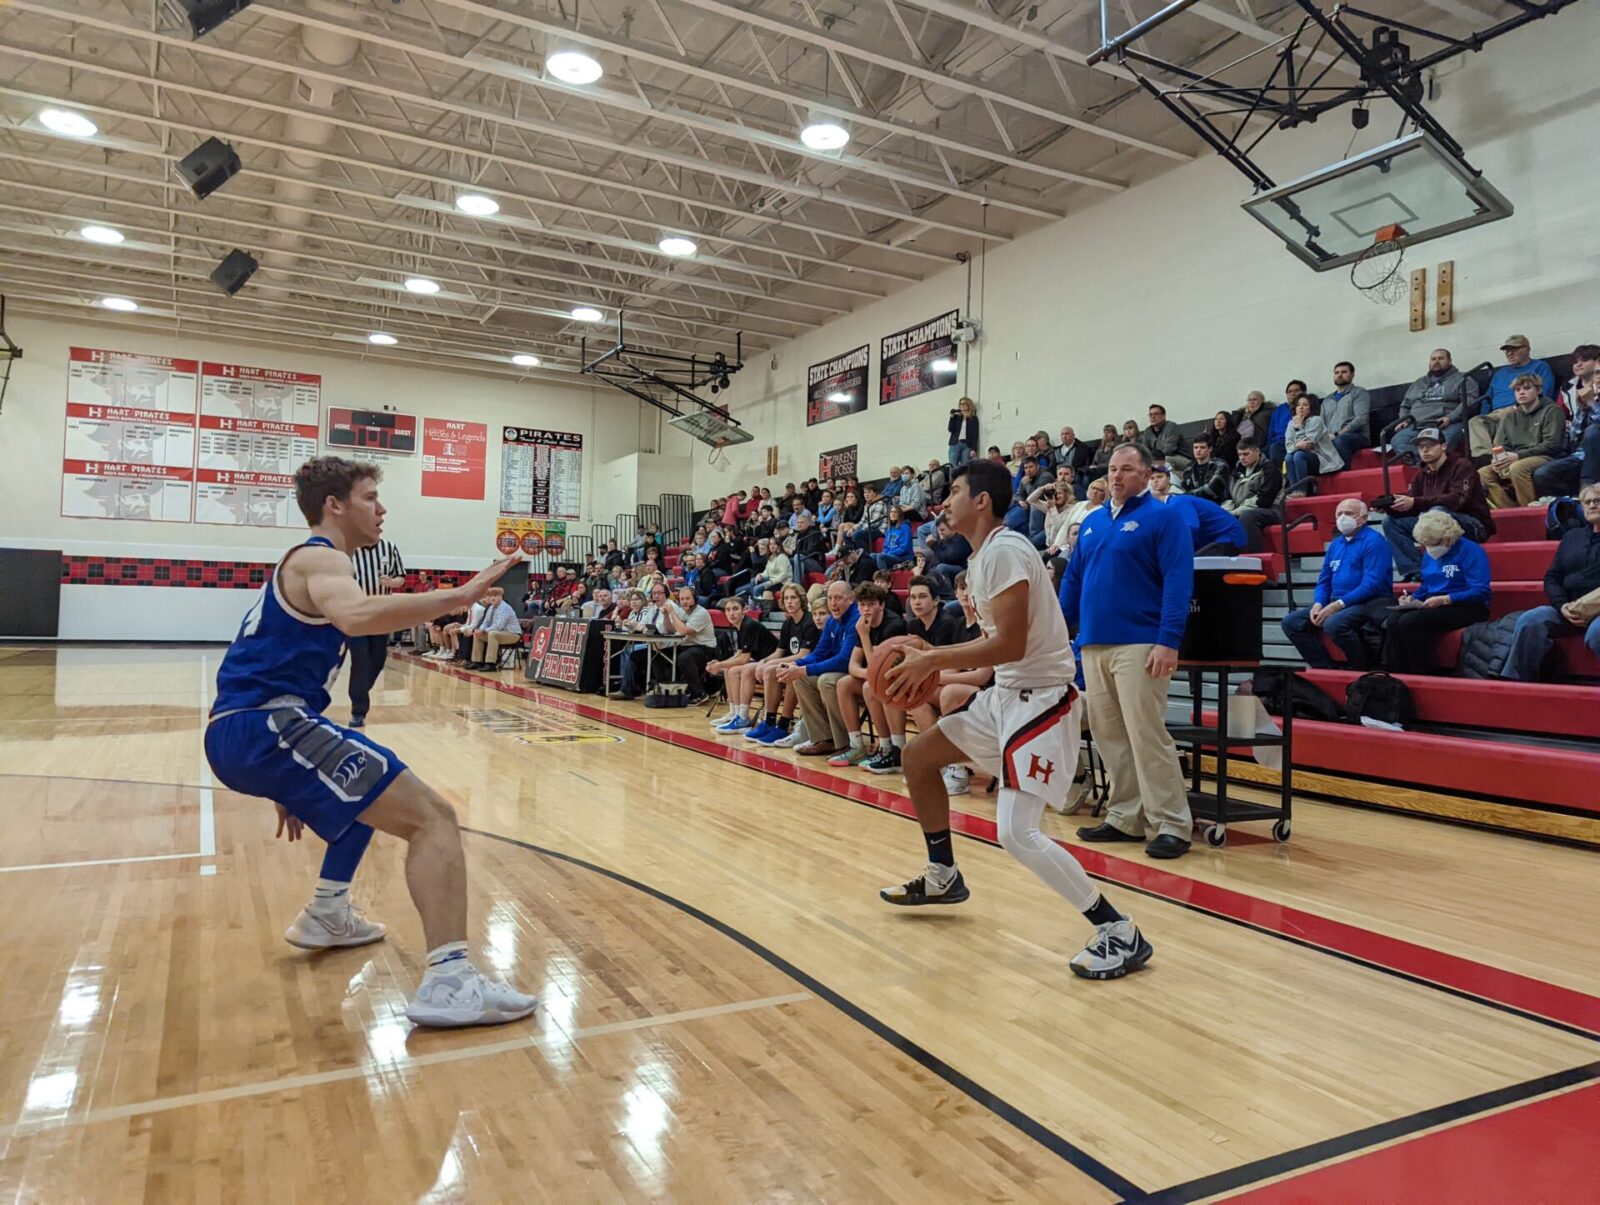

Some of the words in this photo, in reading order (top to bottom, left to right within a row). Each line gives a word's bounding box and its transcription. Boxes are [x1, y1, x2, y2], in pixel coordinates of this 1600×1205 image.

[883, 334, 907, 360] STATE
[908, 311, 958, 348] CHAMPIONS
[810, 363, 829, 386] STATE
[829, 346, 868, 376] CHAMPIONS
[240, 367, 260, 376] HART
[264, 370, 297, 380] PIRATES
[882, 374, 896, 402] H
[107, 407, 129, 416] HART
[134, 410, 170, 420] PIRATES
[808, 400, 821, 424] H
[237, 420, 257, 428] HART
[262, 422, 295, 432] PIRATES
[458, 431, 486, 444] Legends
[520, 429, 580, 441] PIRATES
[833, 450, 856, 465] PARENT
[104, 464, 126, 472] HART
[132, 465, 167, 474] PIRATES
[835, 462, 854, 476] POSSE
[259, 474, 292, 483] PIRATES
[551, 622, 587, 654] HART
[541, 653, 580, 684] PIRATES
[1026, 752, 1055, 786] H
